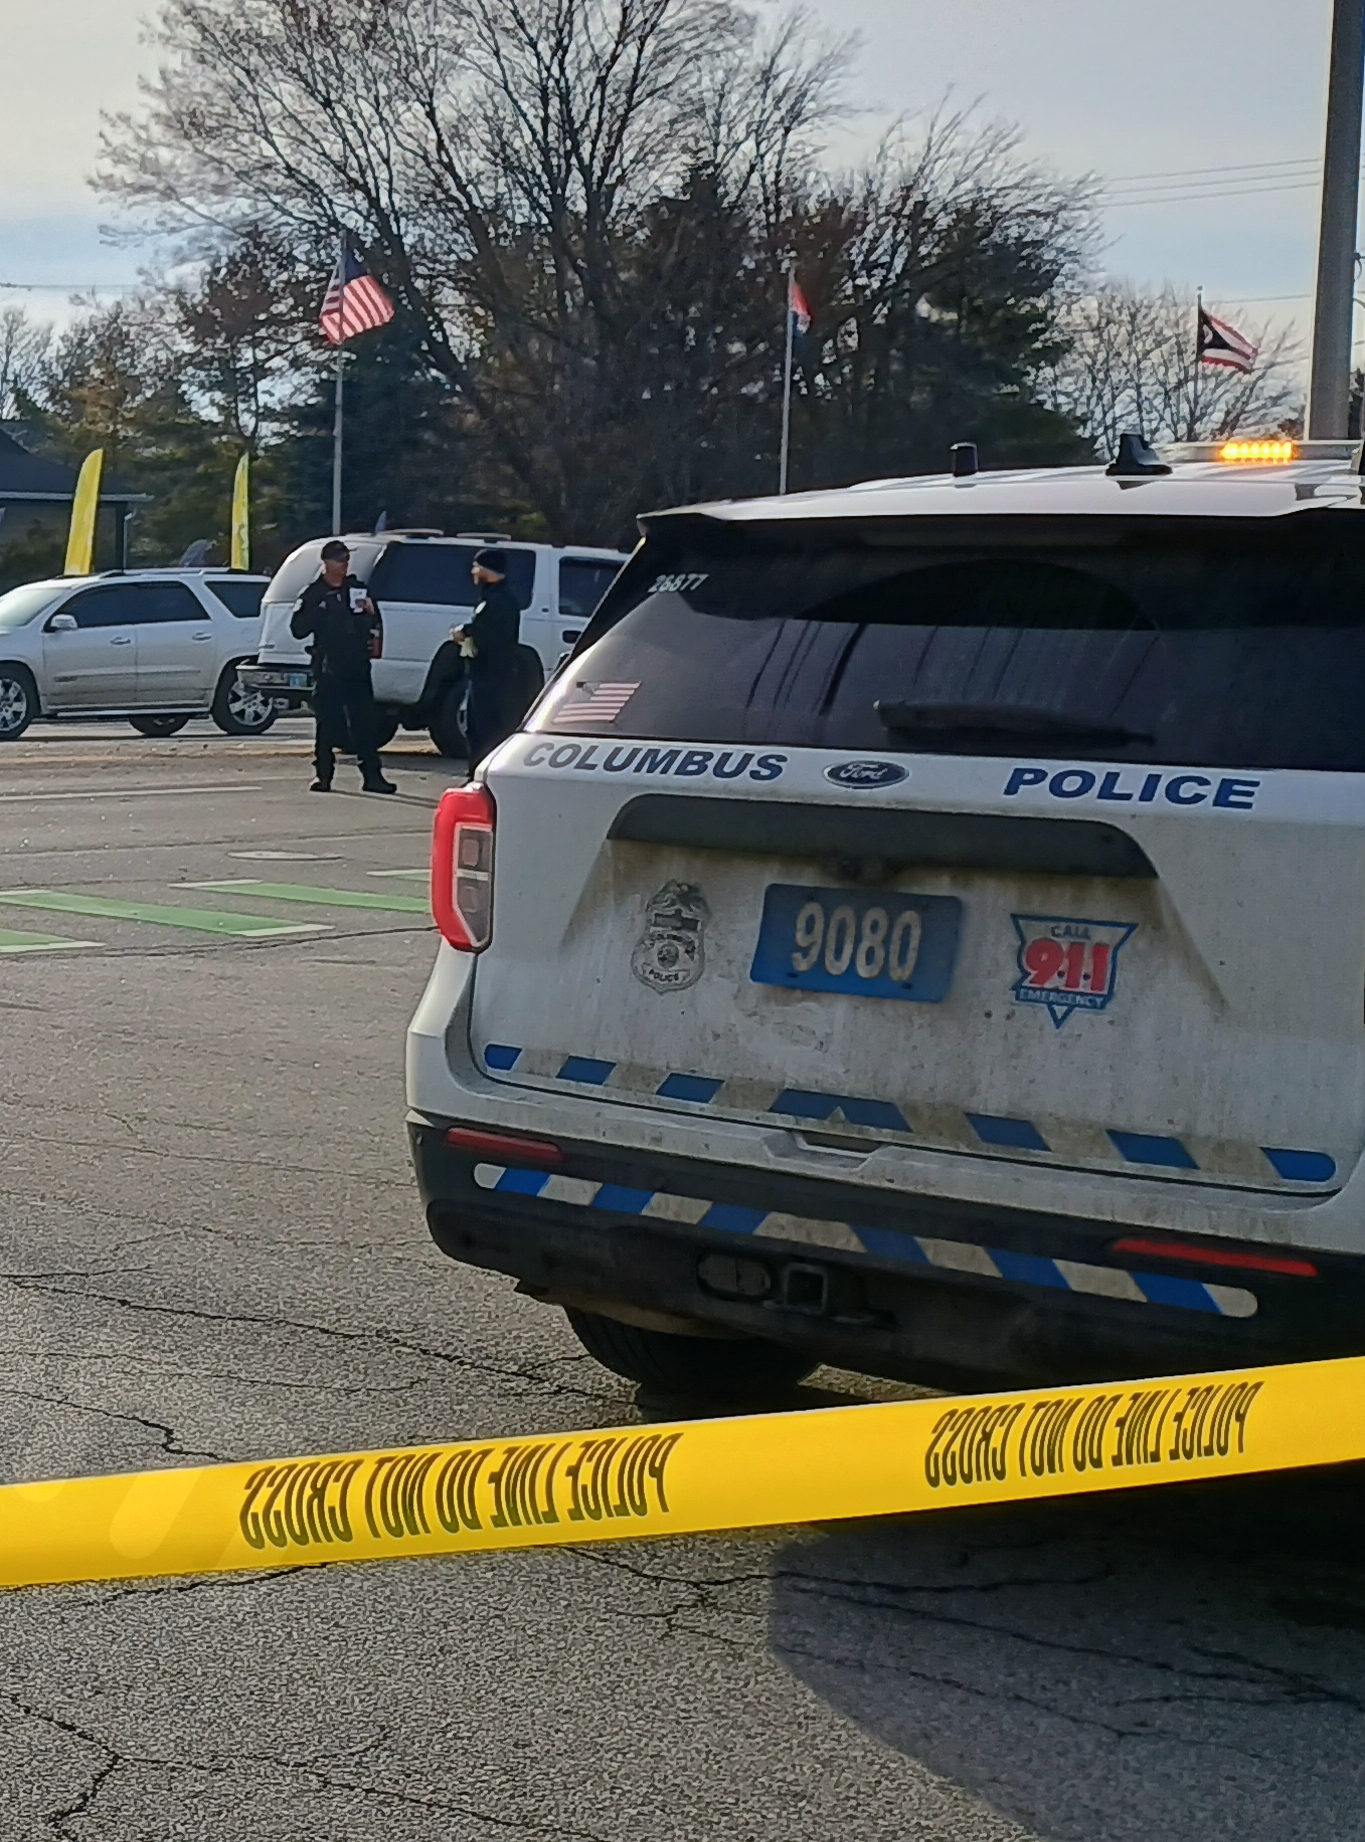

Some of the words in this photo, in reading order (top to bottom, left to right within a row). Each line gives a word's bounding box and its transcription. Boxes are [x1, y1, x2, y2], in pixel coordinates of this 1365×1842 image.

[523, 742, 788, 782] COLUMBUS
[1004, 767, 1261, 810] POLICE
[791, 901, 922, 982] 9080
[1050, 925, 1092, 941] CALL
[1019, 988, 1105, 1008] EMERGENCY
